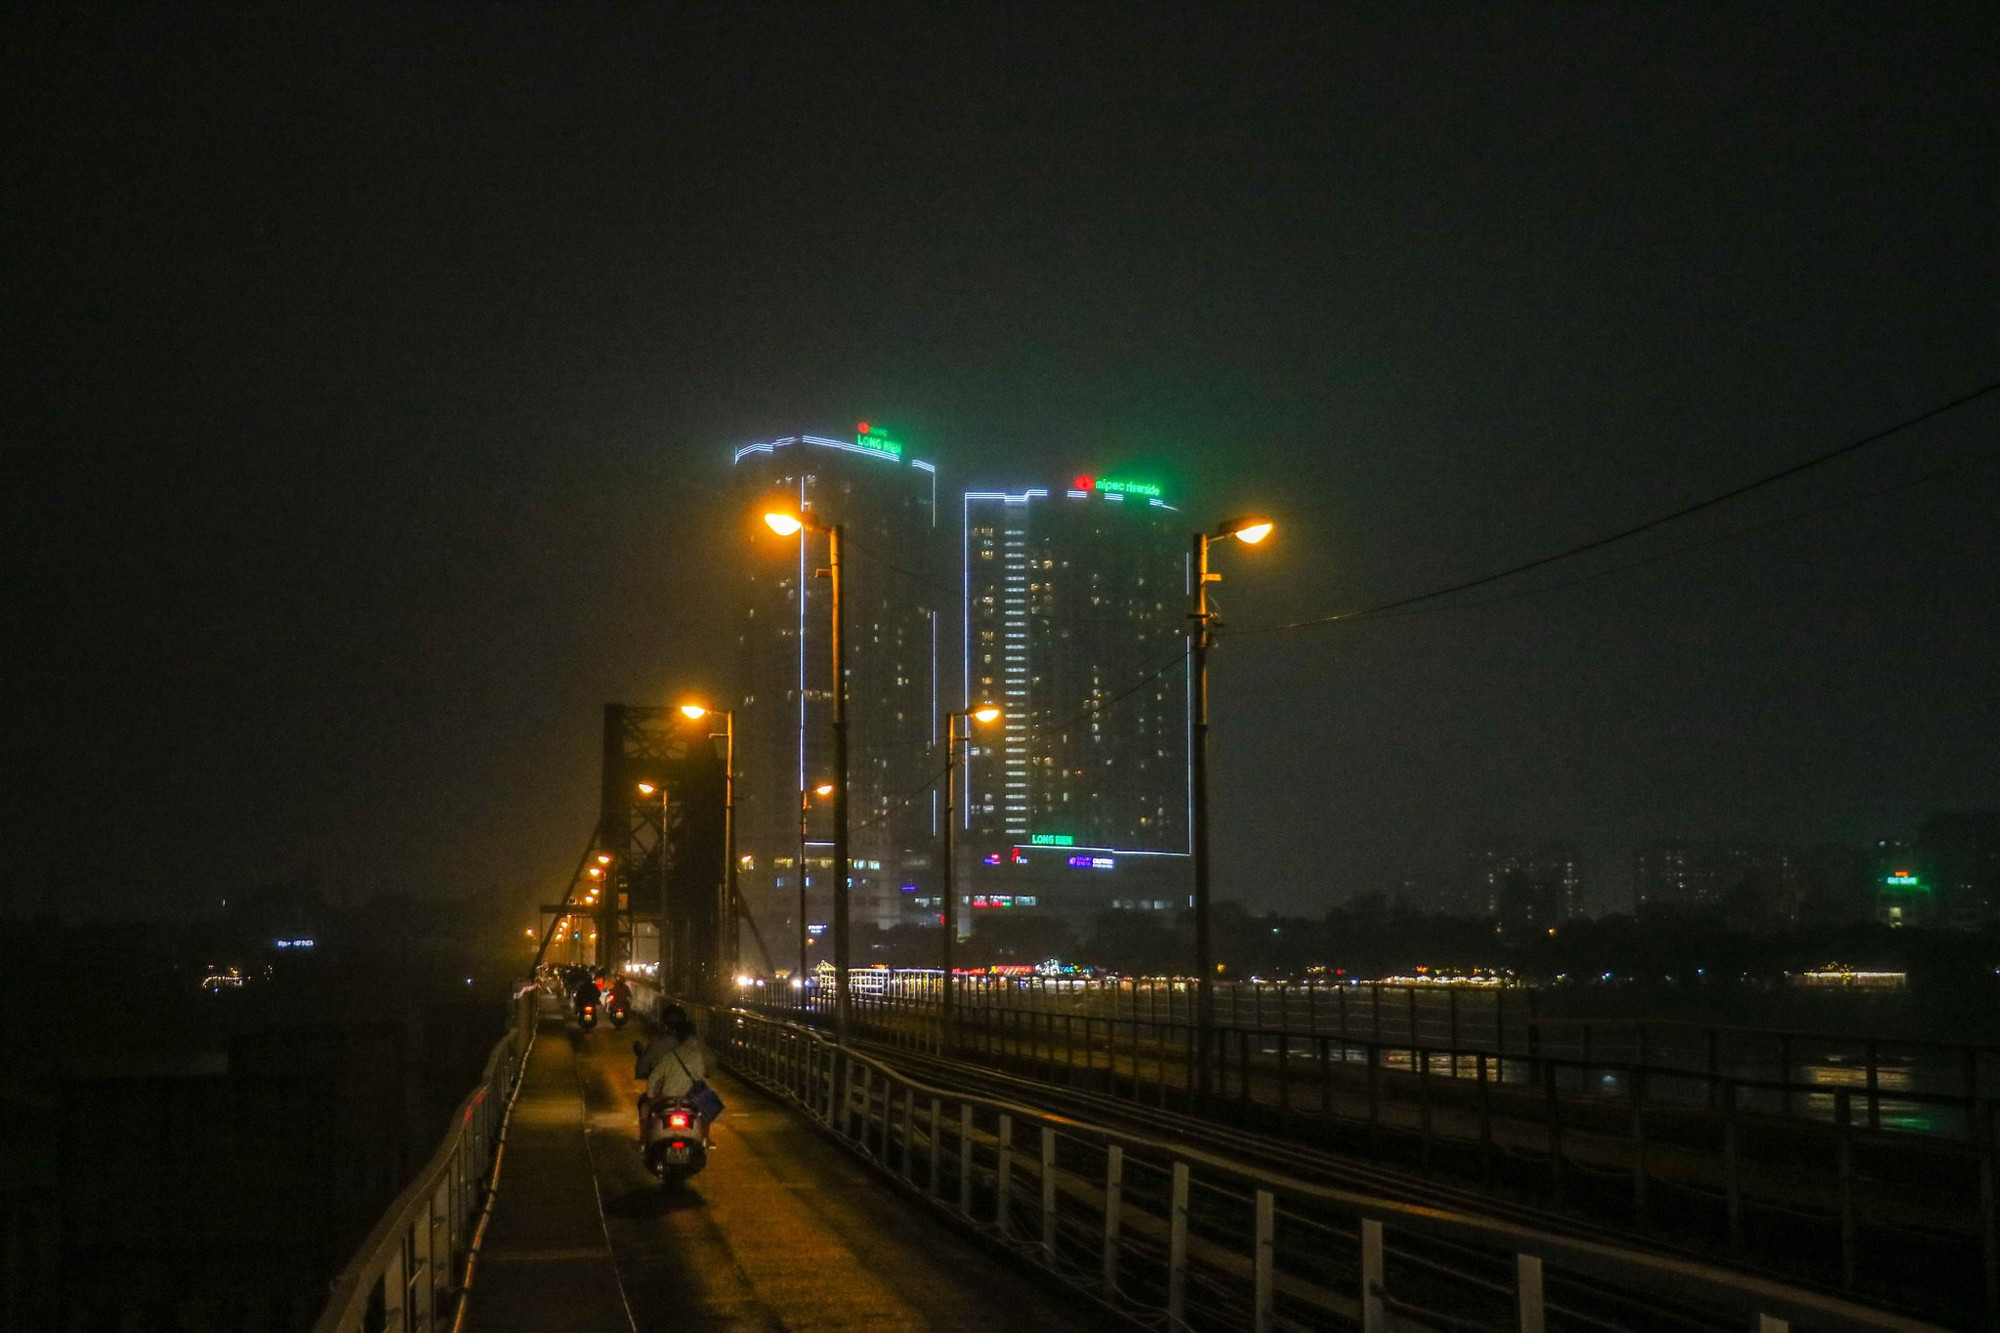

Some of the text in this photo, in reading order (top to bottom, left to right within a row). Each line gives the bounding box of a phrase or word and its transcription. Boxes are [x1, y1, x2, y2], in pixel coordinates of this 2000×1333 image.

[857, 434, 882, 450] LONG
[1095, 479, 1125, 491] mipec
[1031, 834, 1054, 845] LONG
